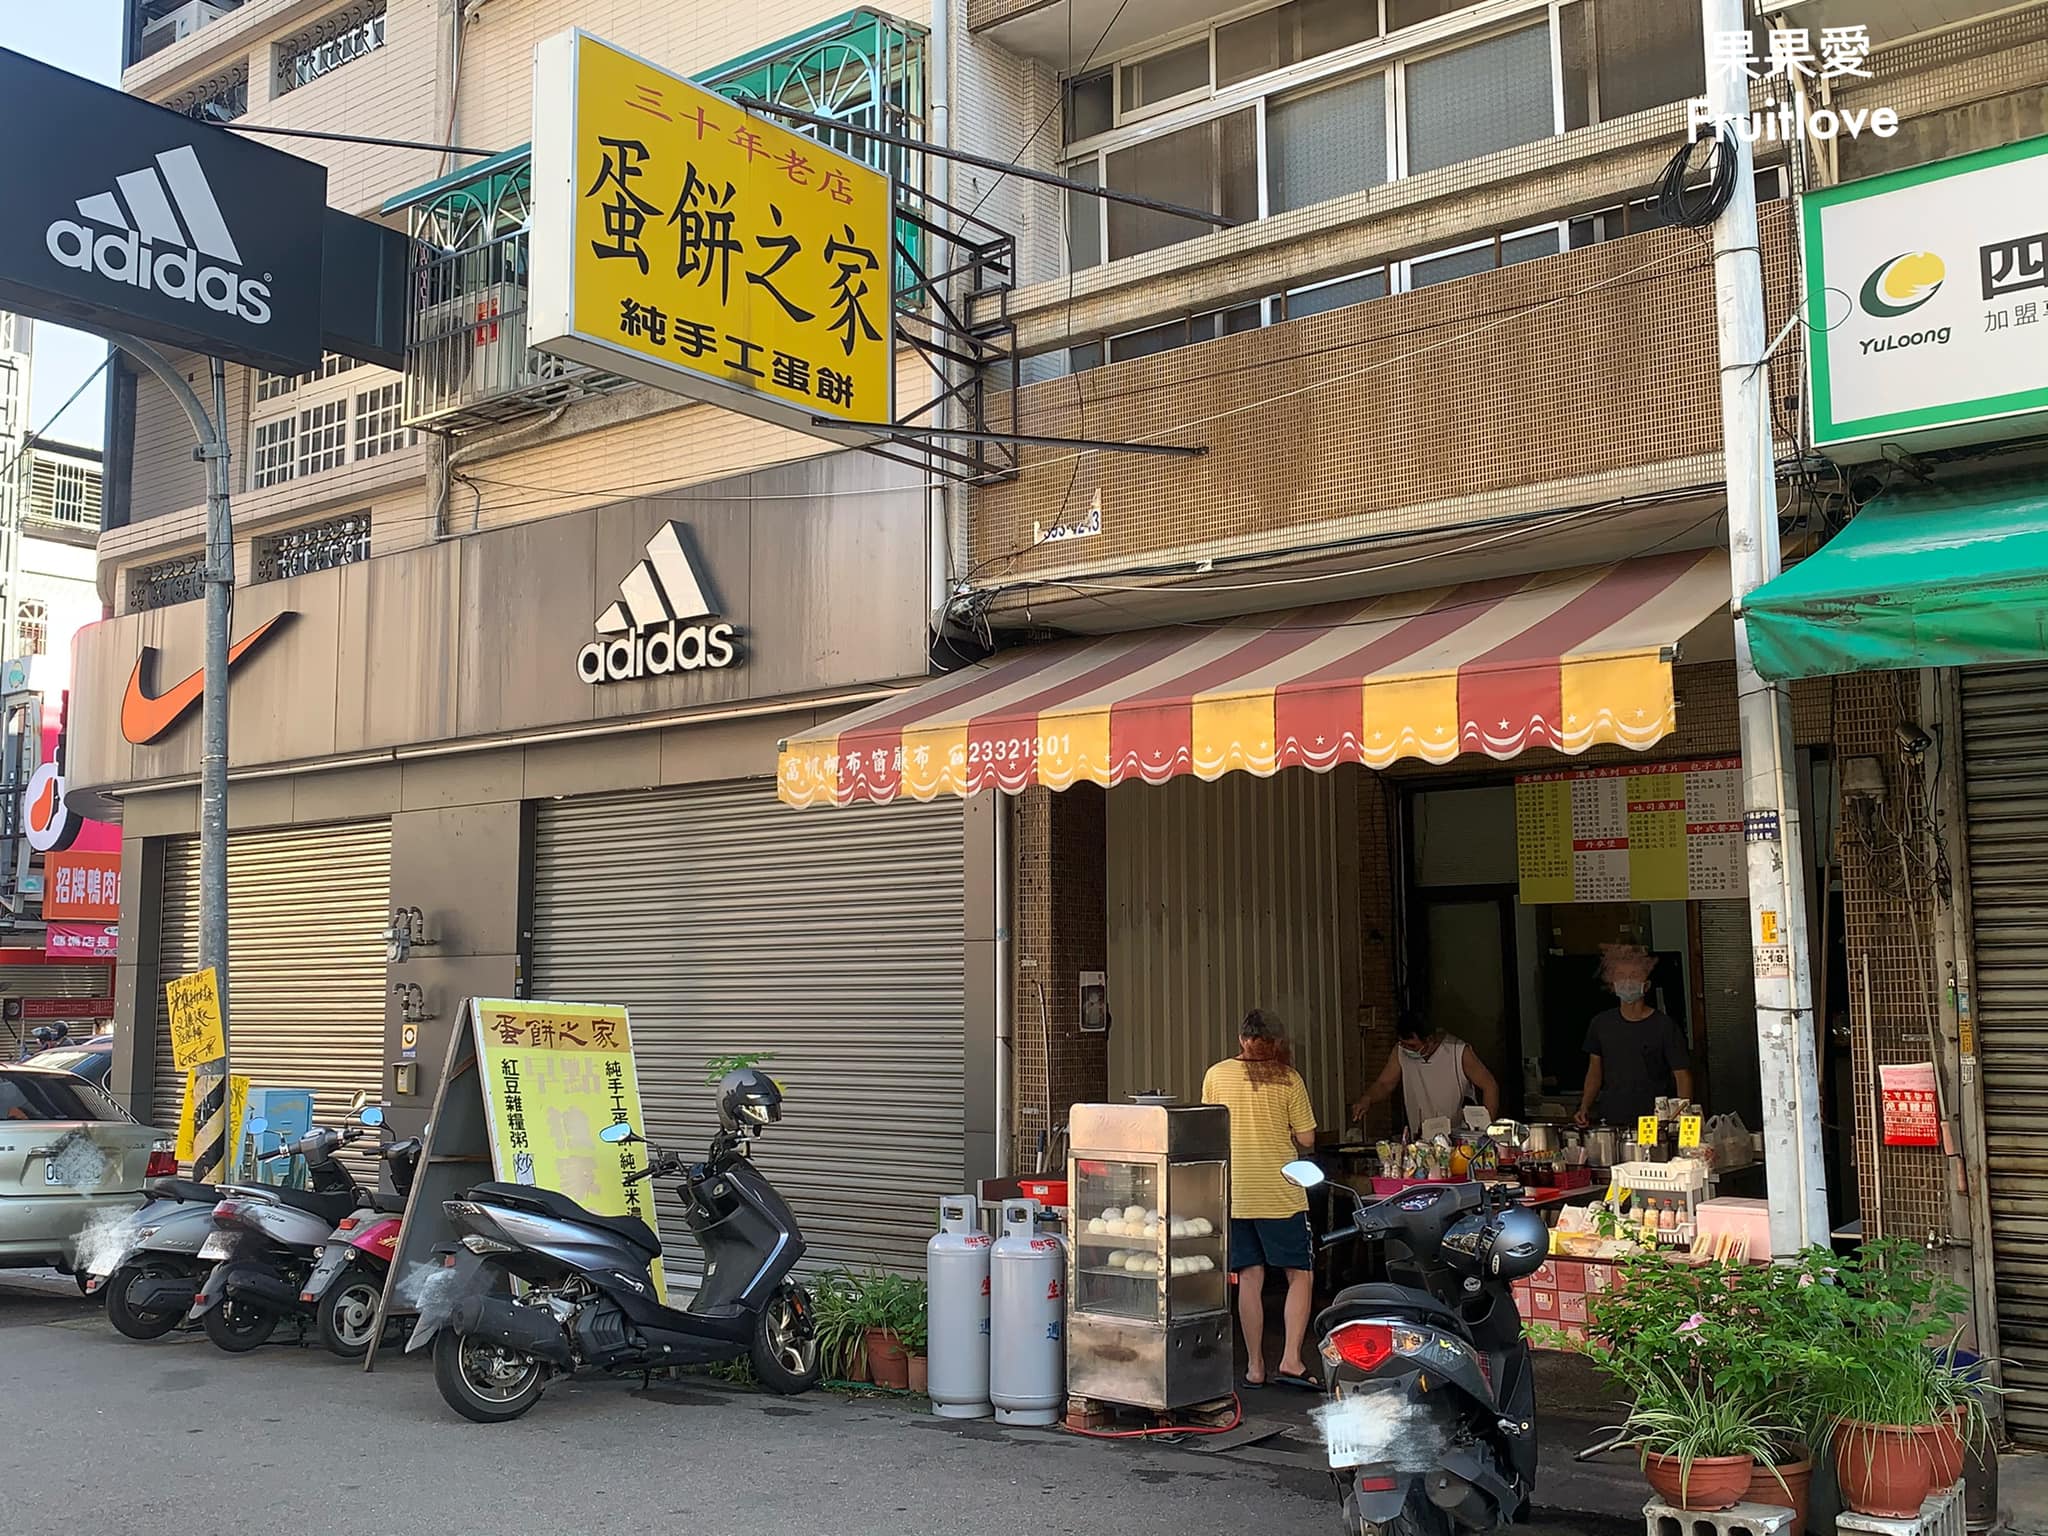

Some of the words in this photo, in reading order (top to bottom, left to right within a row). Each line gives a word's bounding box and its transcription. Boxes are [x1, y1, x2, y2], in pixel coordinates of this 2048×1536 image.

[624, 83, 854, 206] 三十年老店
[45, 217, 273, 325] adidas
[585, 135, 884, 357] 蛋餅之家
[619, 297, 854, 409] 純手工蛋餅
[1859, 325, 1952, 355] YuLoong
[575, 619, 742, 686] adidas
[968, 735, 1071, 764] 23321301
[490, 1014, 620, 1048] 蛋餅之家
